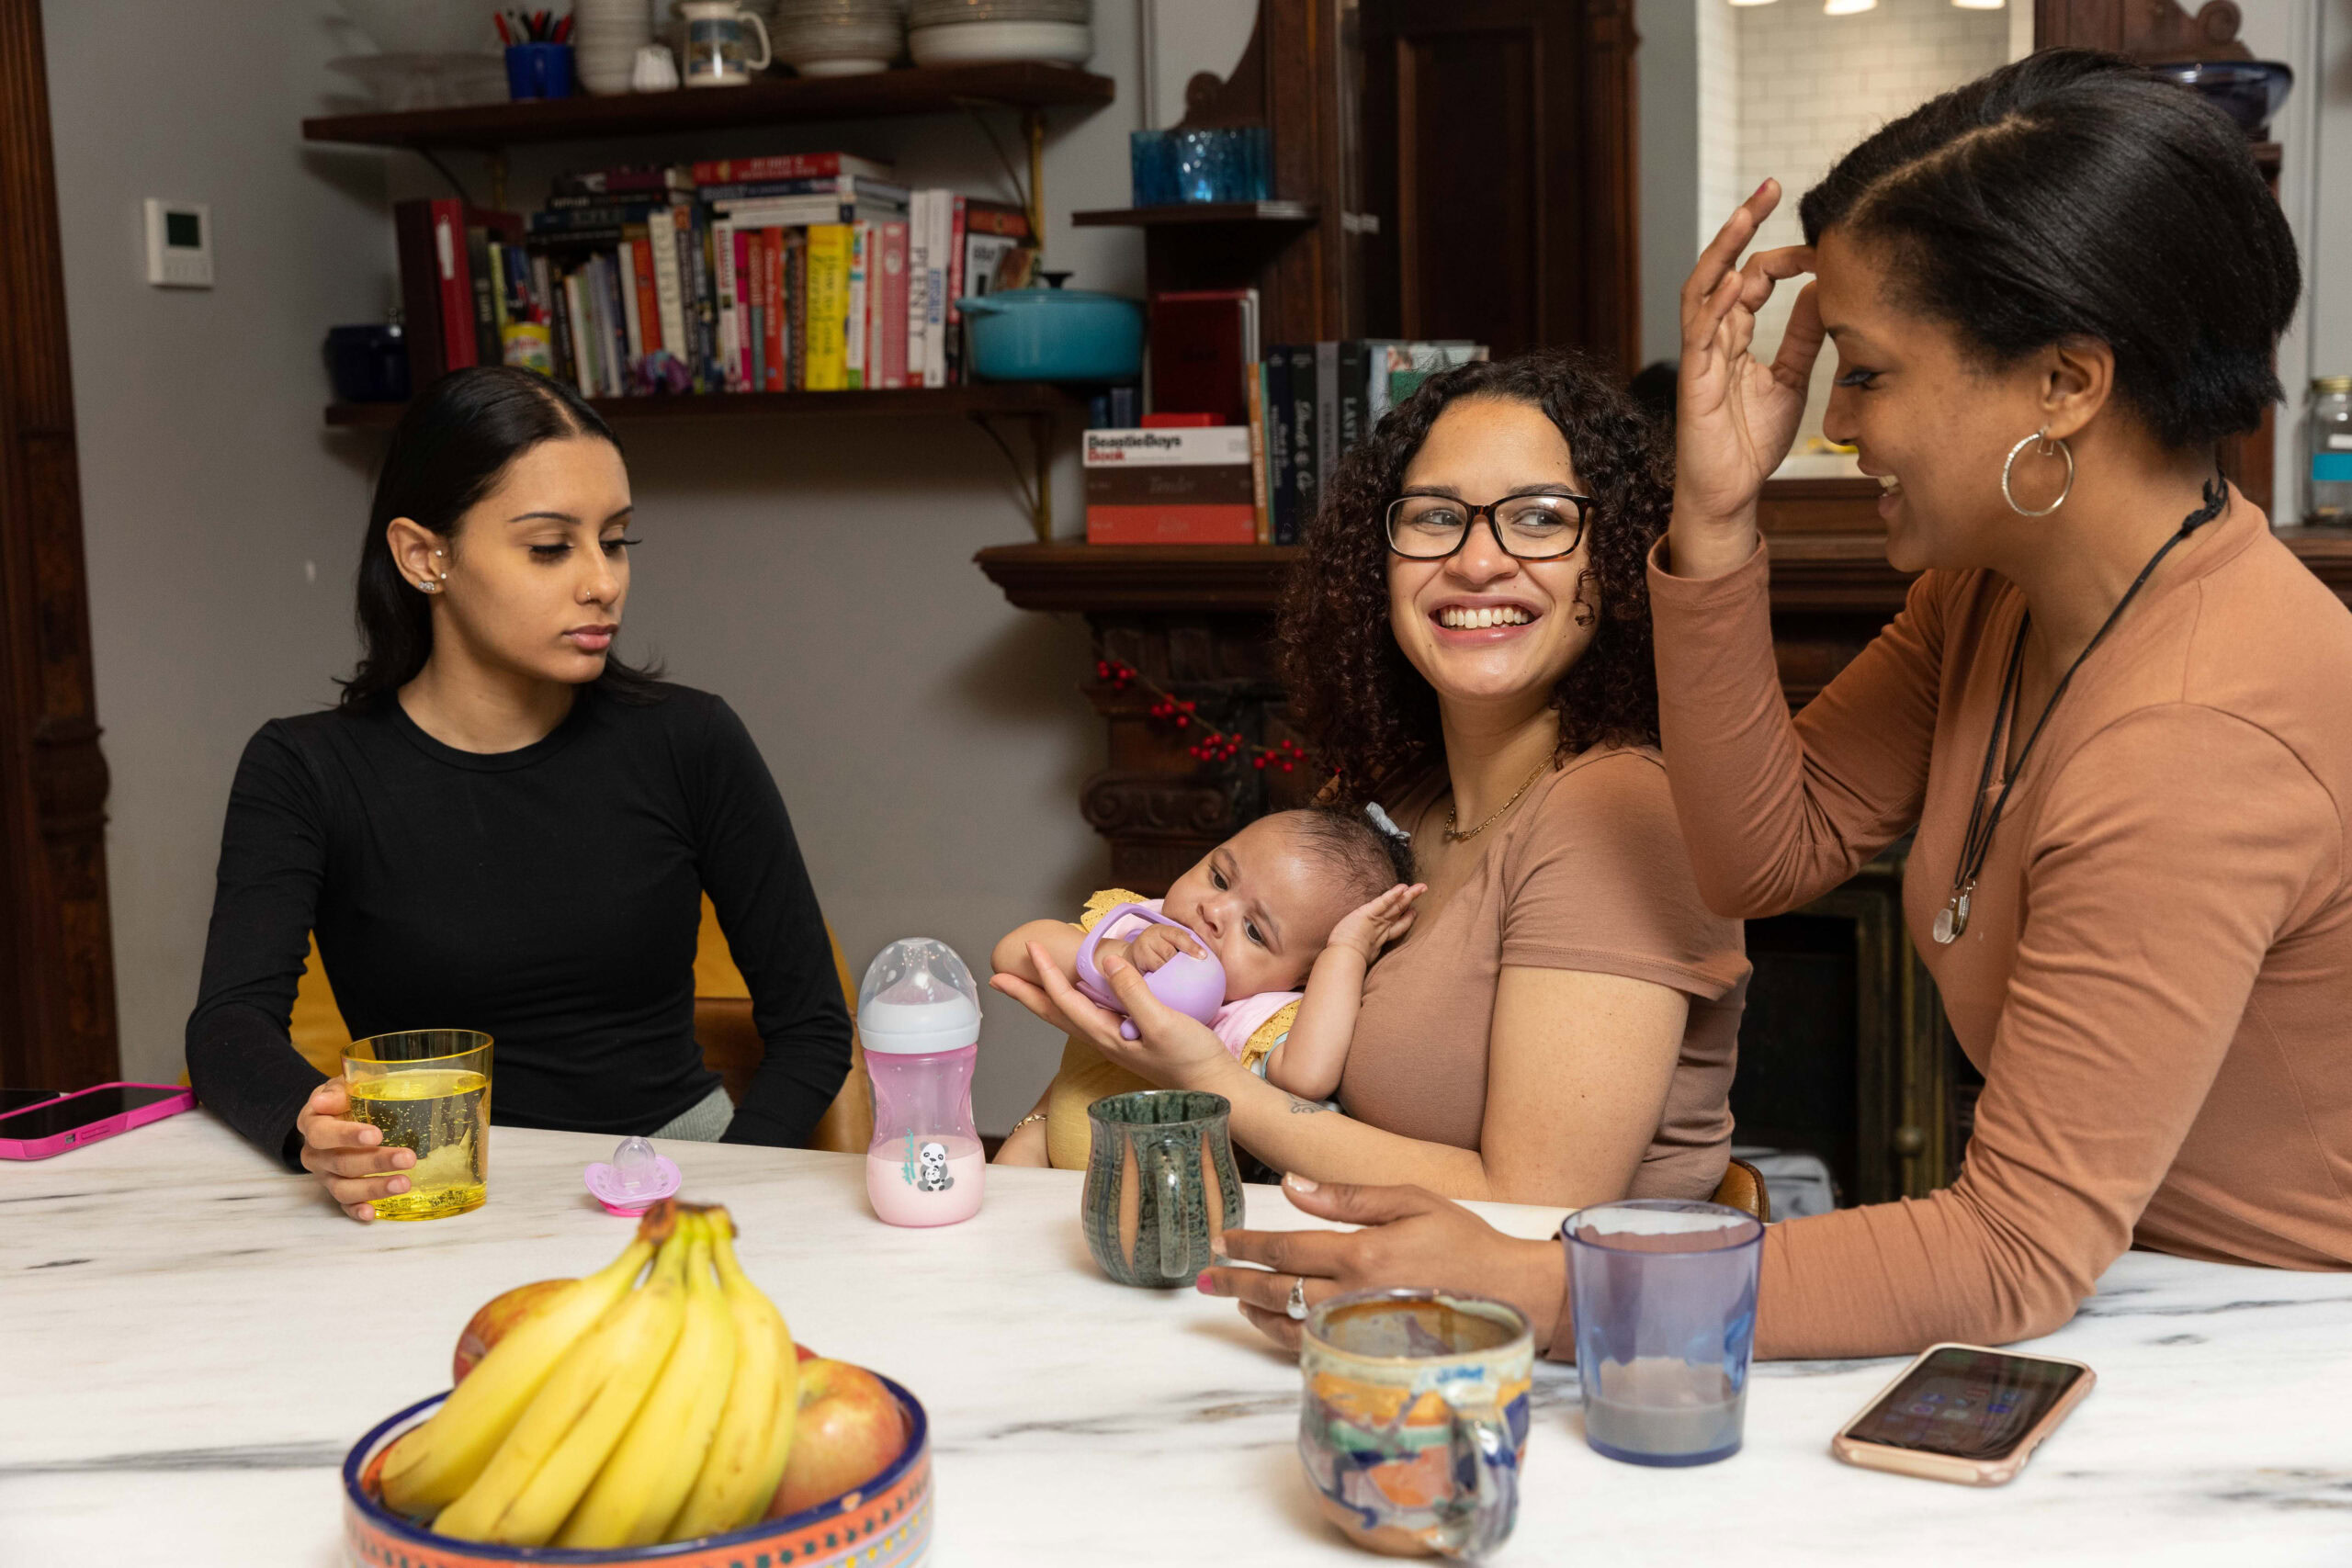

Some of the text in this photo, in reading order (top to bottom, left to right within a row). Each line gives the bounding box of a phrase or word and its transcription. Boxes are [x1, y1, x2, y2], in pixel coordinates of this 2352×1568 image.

[1342, 397, 1358, 439] LAST
[1088, 434, 1182, 449] BeastieBoys
[1088, 447, 1125, 462] Book
